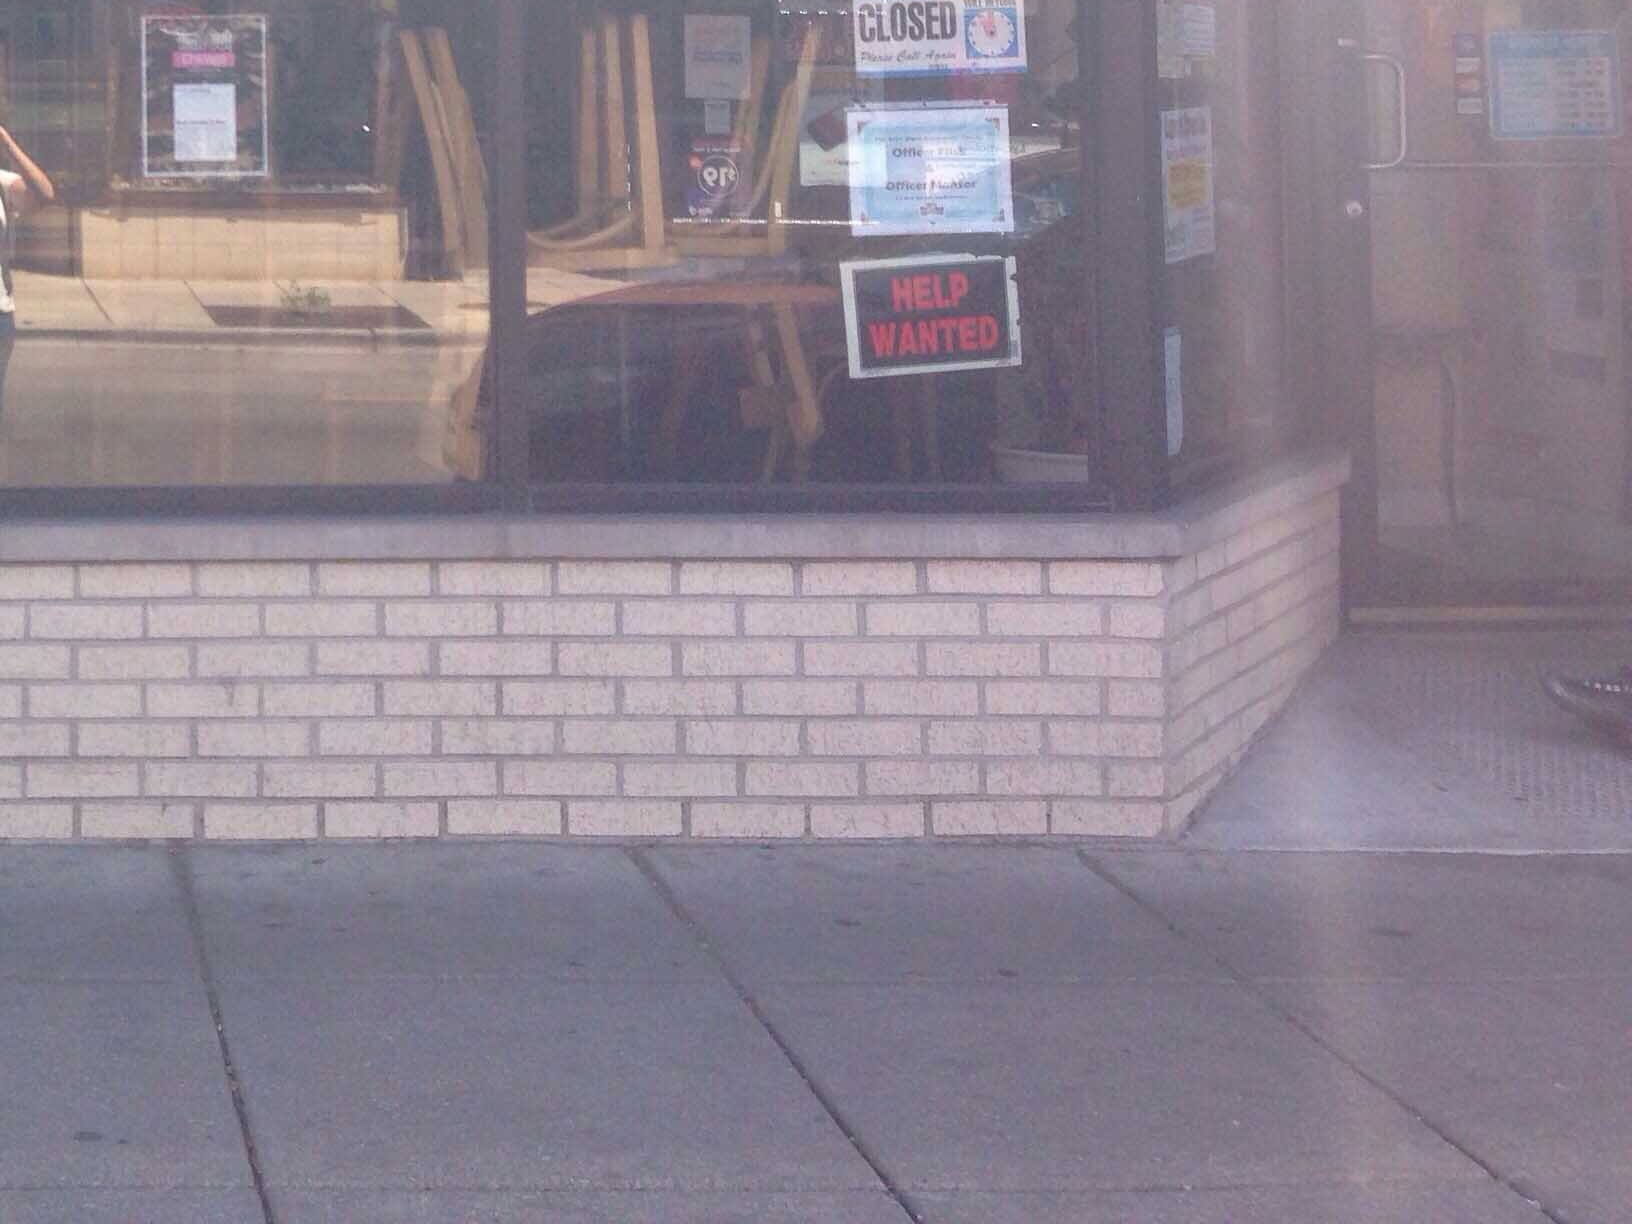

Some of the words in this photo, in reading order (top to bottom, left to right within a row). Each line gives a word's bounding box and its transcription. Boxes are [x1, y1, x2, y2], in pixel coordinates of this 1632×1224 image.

[858, 1, 957, 43] CLOSED
[890, 271, 969, 313] HELP
[869, 314, 999, 358] WANTED
